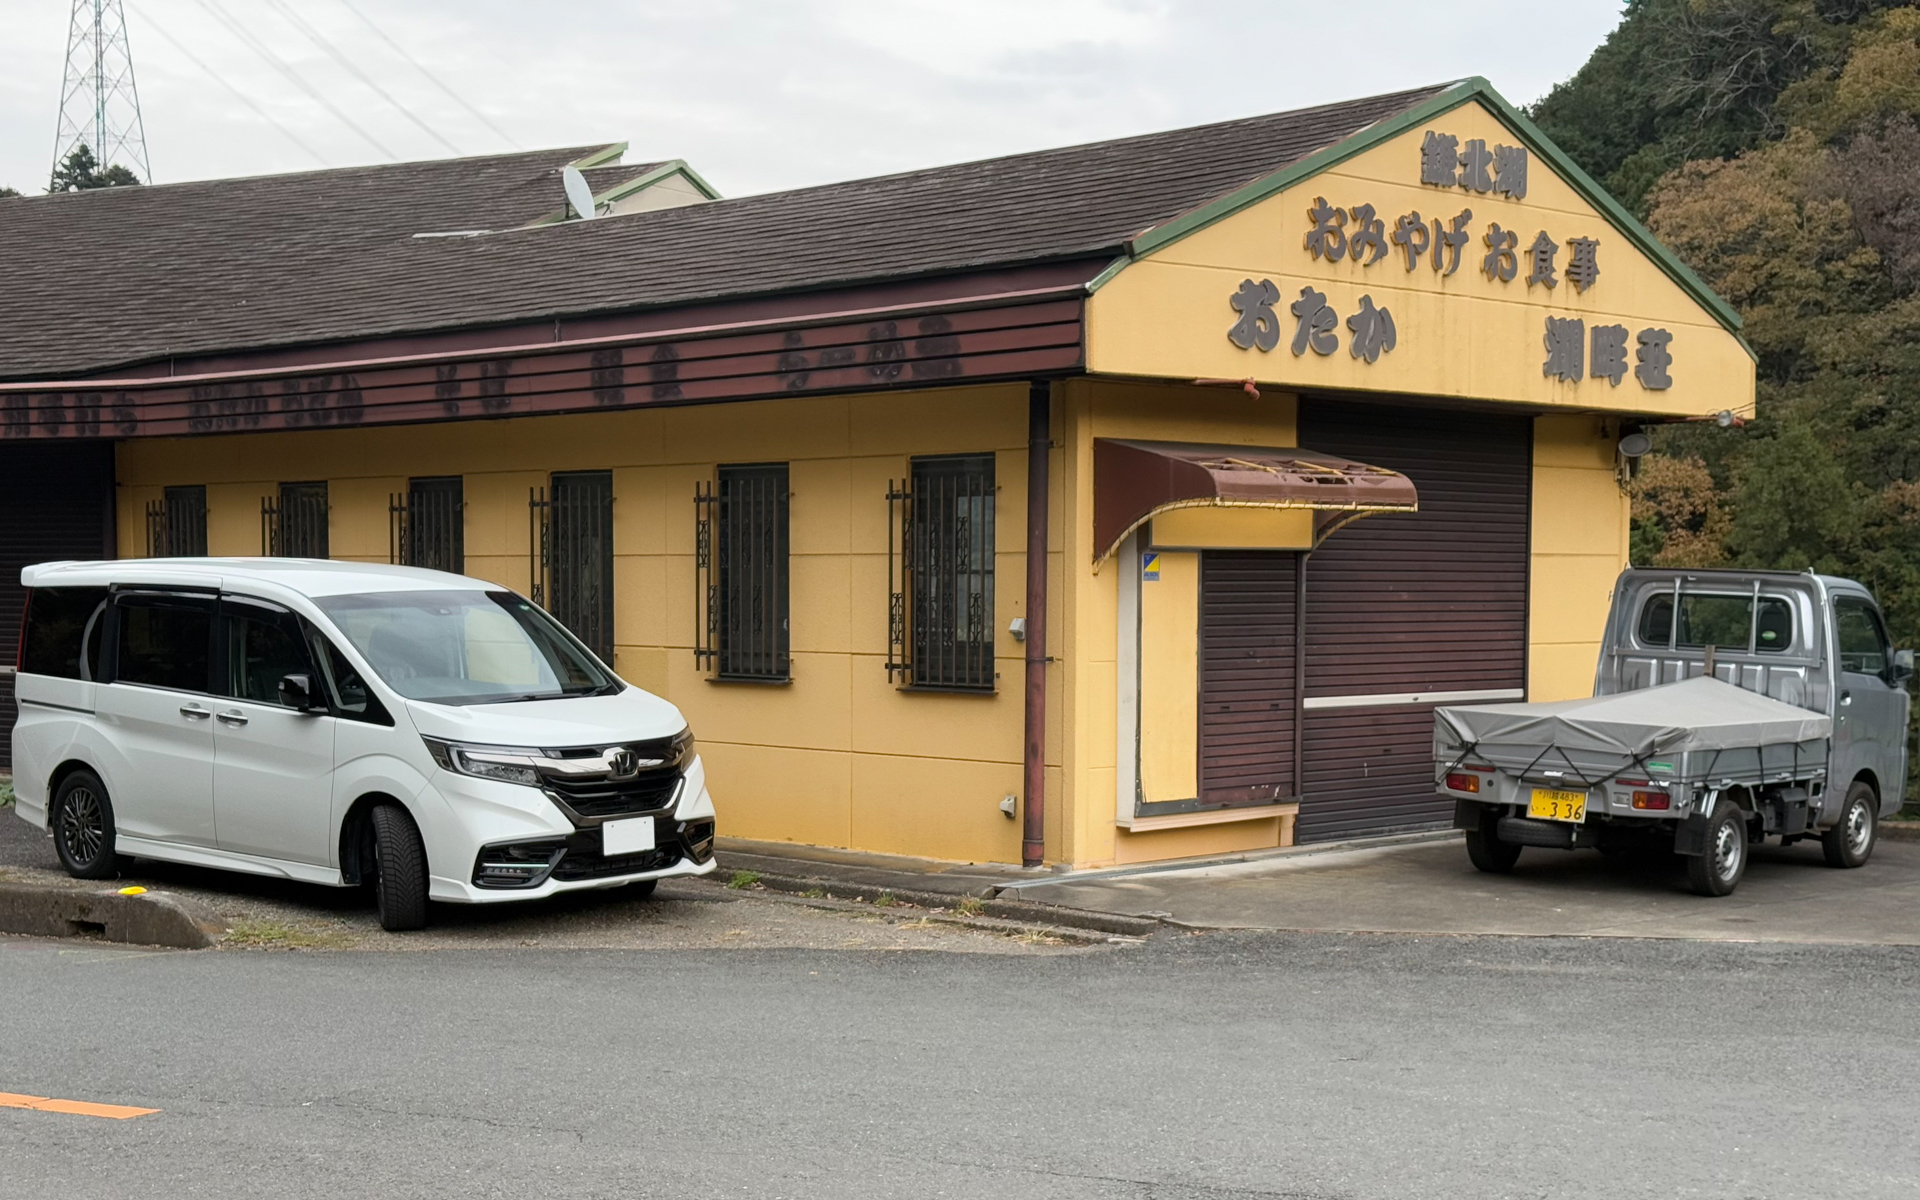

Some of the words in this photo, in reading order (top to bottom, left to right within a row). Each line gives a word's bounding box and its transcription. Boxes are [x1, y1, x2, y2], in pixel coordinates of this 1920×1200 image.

[1303, 196, 1473, 277] おみやげ
[1480, 222, 1600, 295] お食事
[1227, 278, 1396, 364] おたか
[1542, 314, 1673, 390] 湖畔荘
